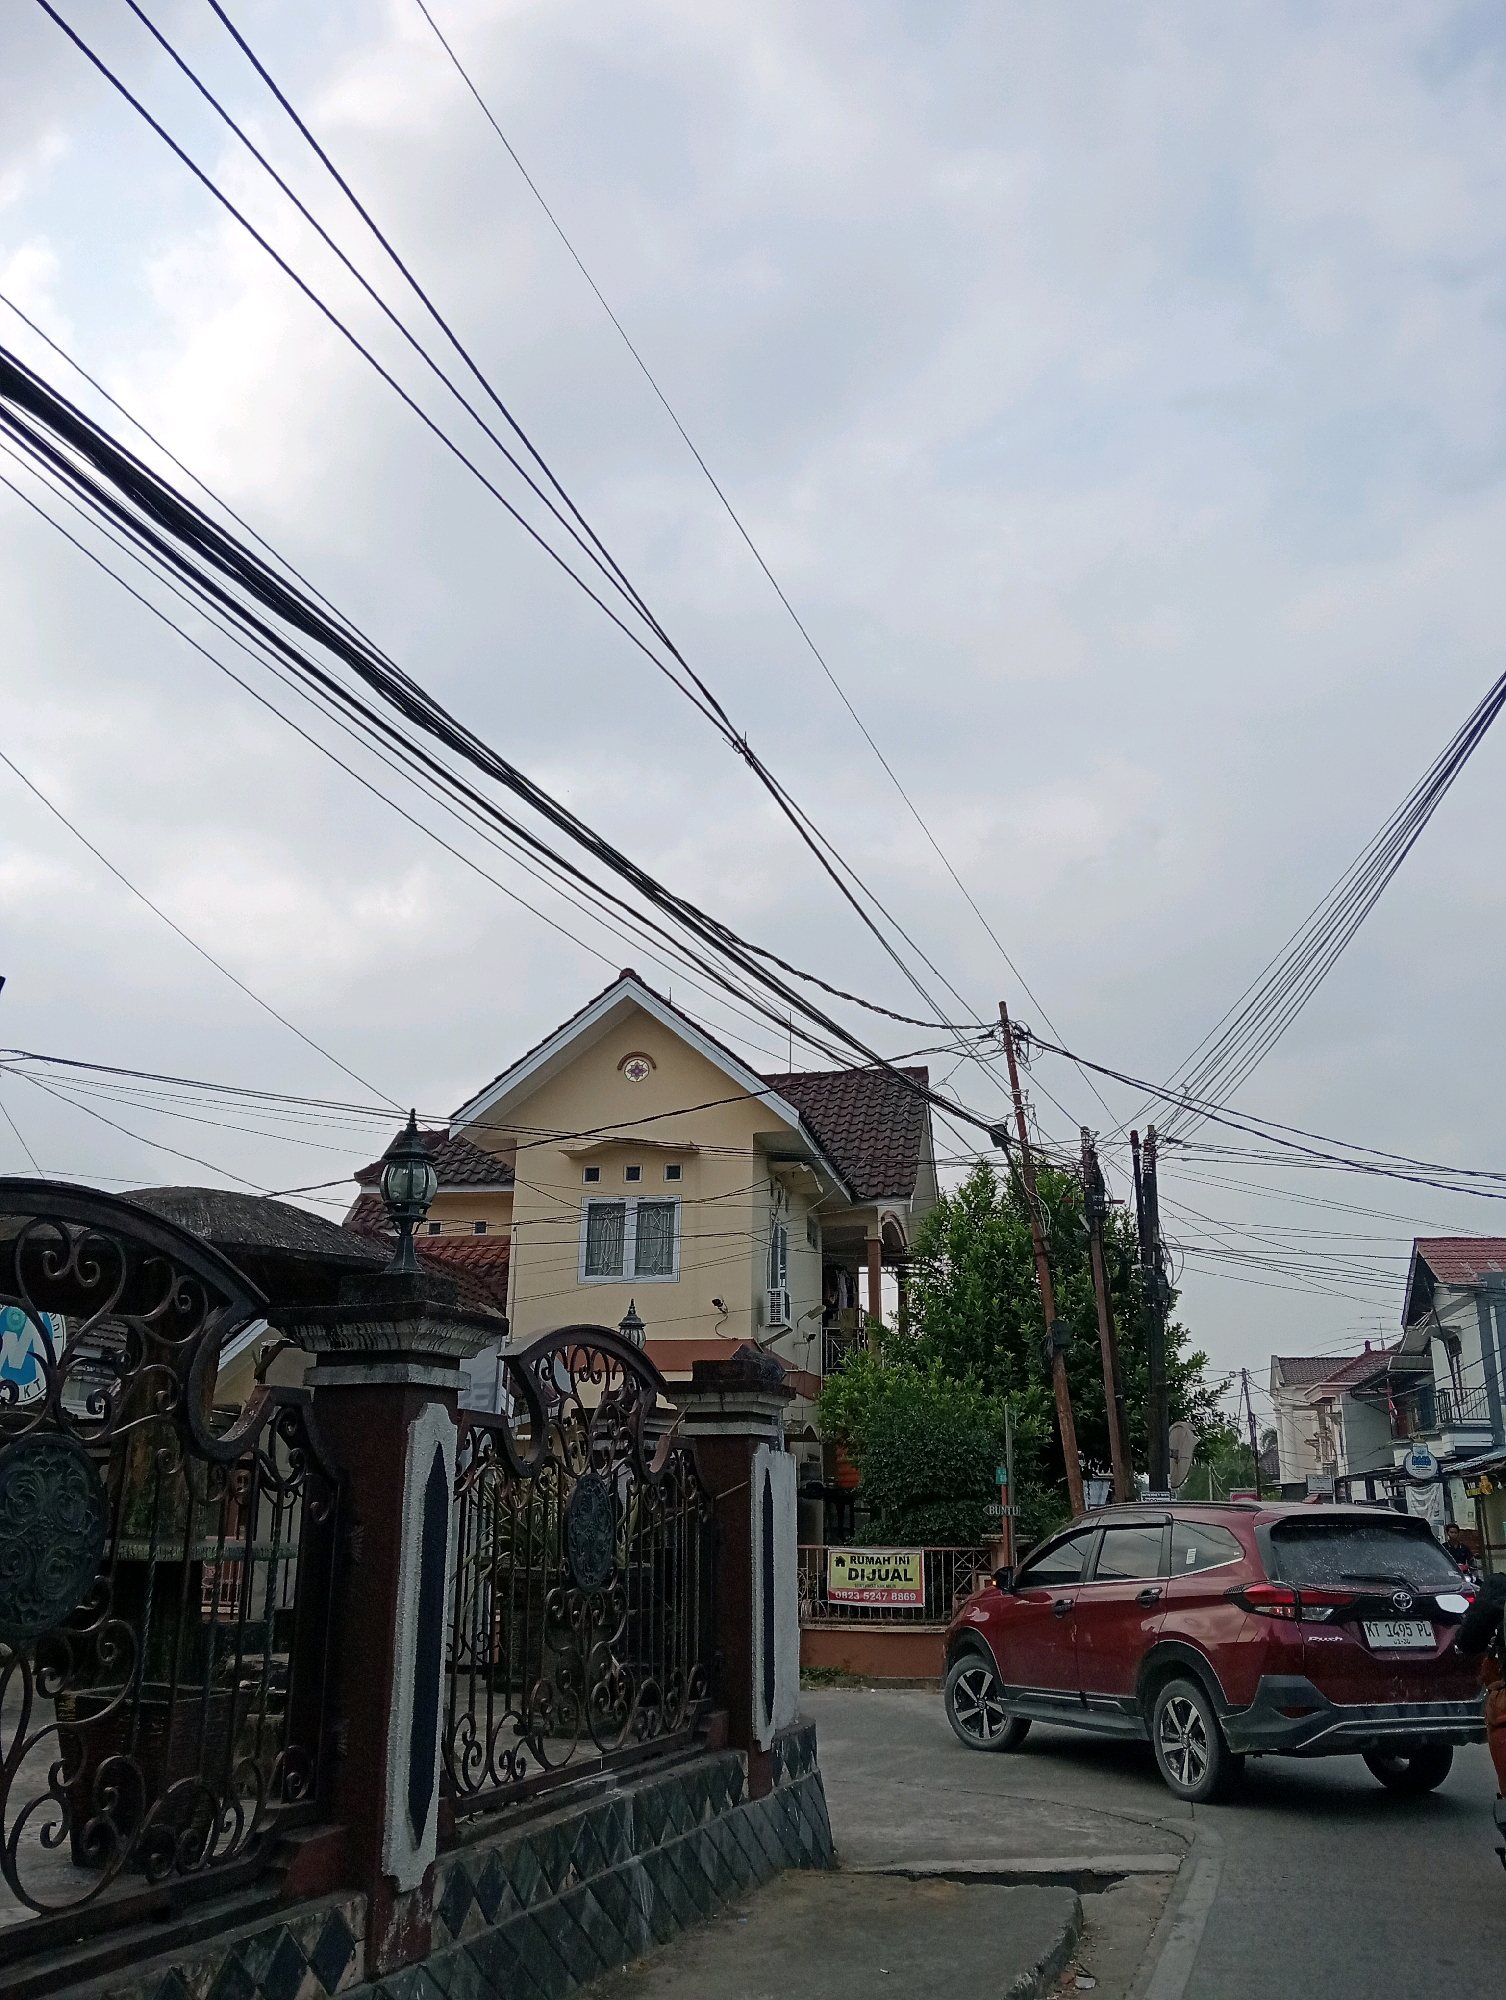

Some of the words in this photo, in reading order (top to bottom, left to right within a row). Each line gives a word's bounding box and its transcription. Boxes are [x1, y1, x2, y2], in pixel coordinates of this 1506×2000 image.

[849, 1555, 891, 1566] RUMAH
[894, 1555, 911, 1566] INI
[847, 1568, 914, 1582] DIJUAL
[835, 1591, 860, 1601] 0823
[863, 1592, 888, 1602] 5247
[891, 1592, 917, 1602] 8869
[1365, 1623, 1380, 1637] KT
[1385, 1623, 1413, 1637] 1495
[1416, 1623, 1431, 1637] PL
